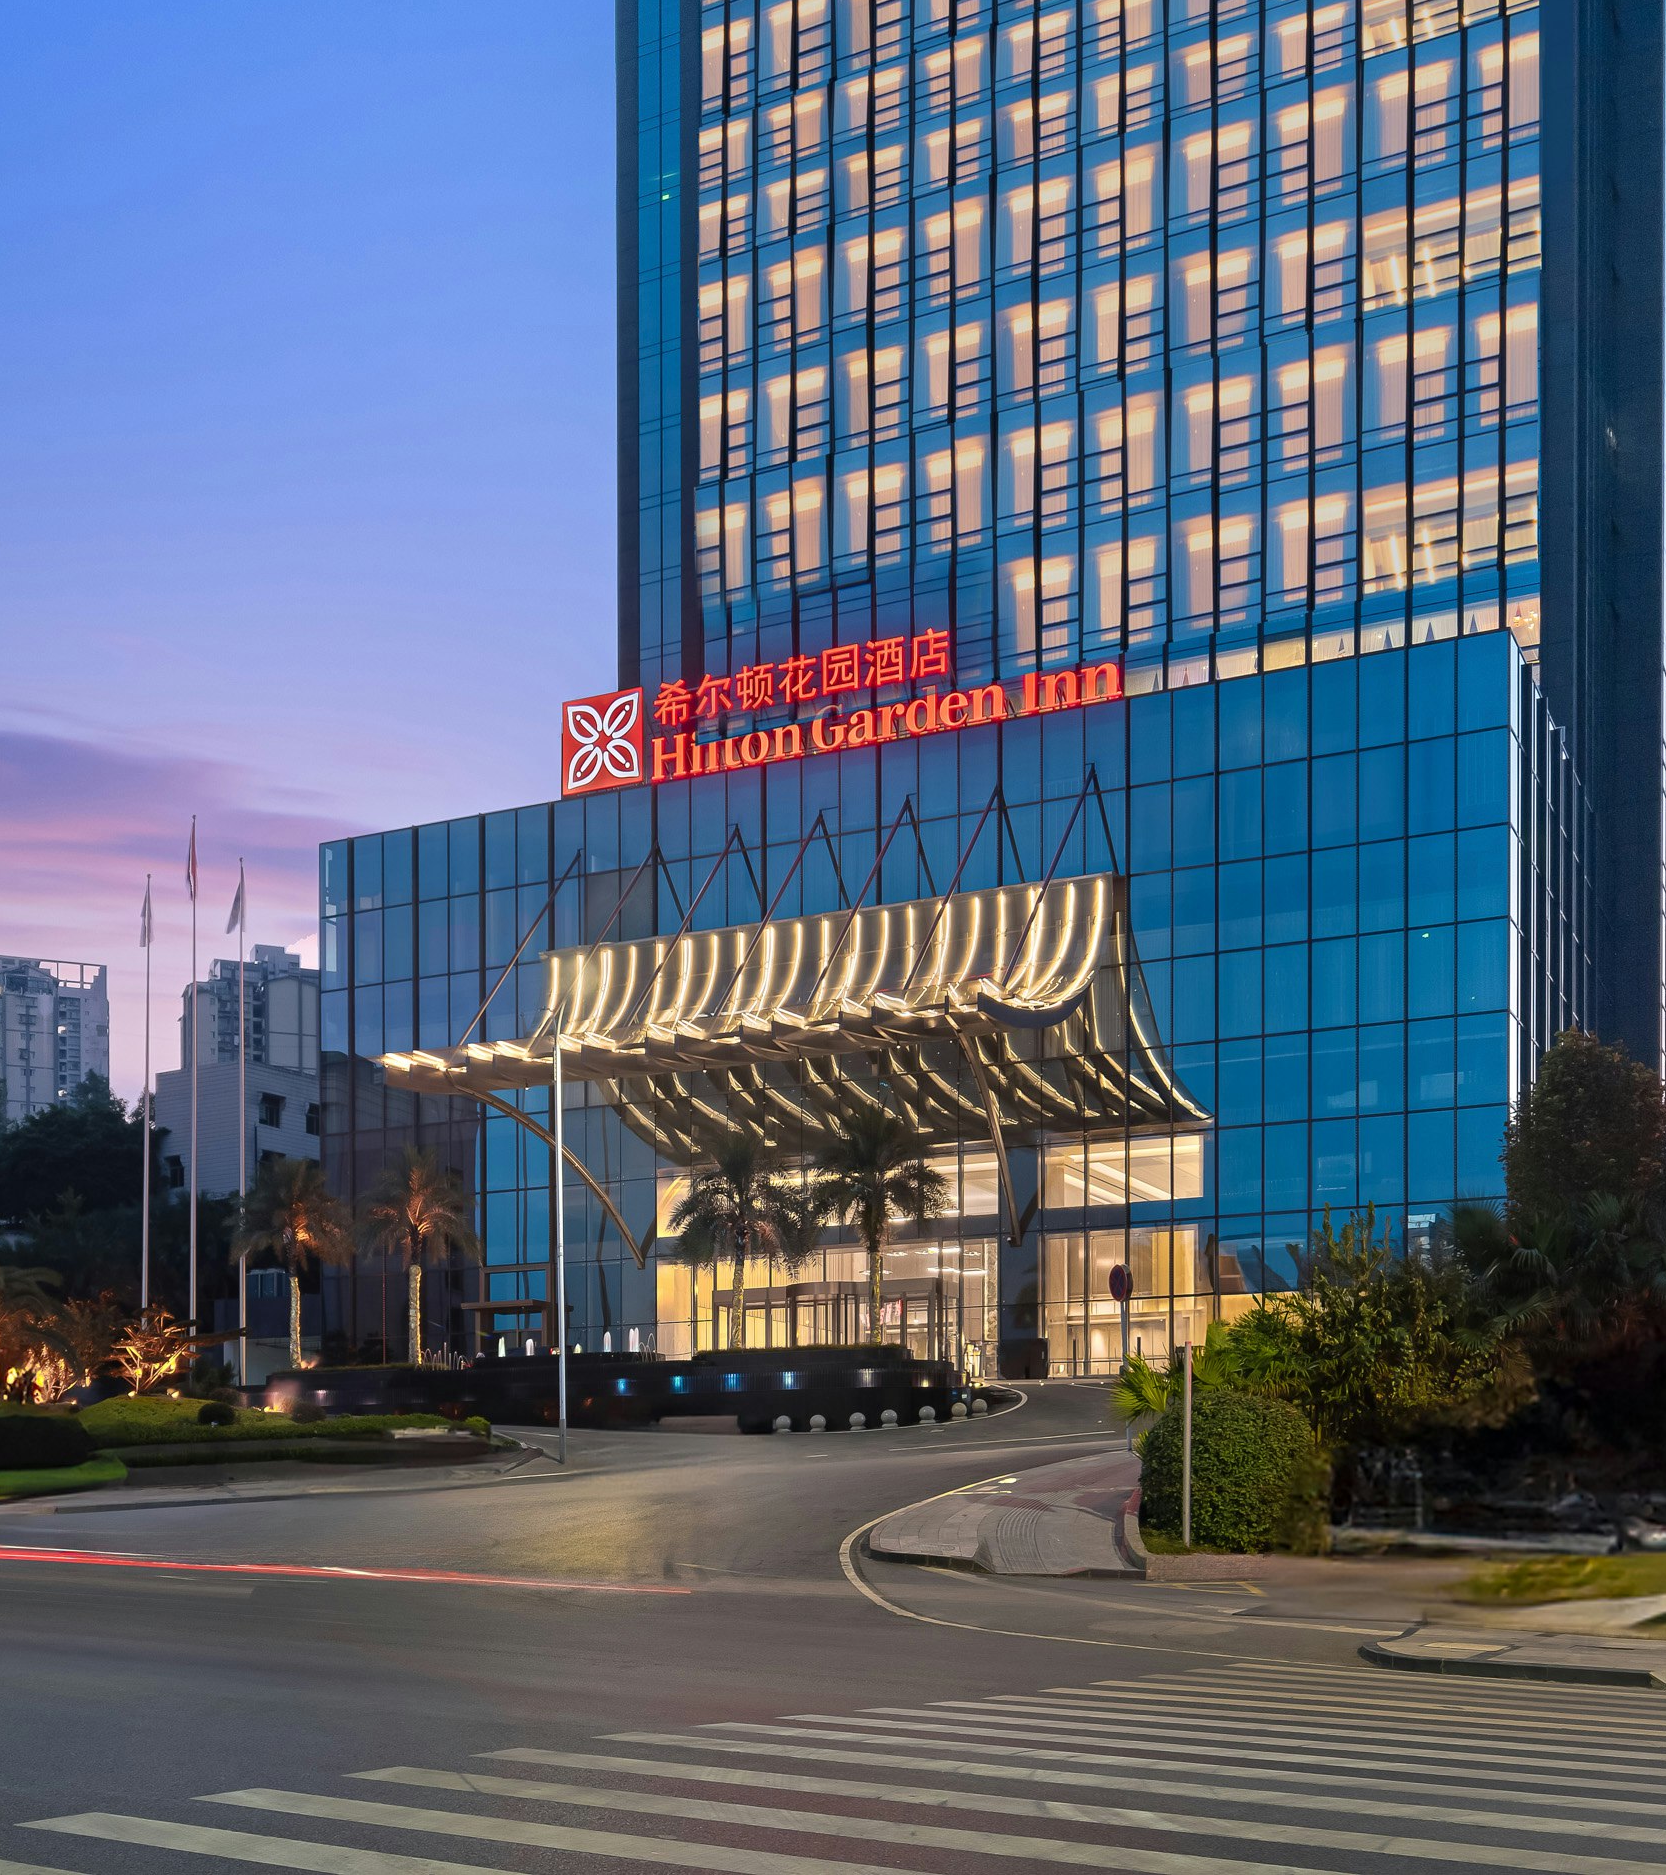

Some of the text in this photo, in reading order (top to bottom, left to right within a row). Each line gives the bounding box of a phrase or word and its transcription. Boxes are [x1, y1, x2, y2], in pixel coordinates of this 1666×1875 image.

[653, 628, 949, 726] 希尔顿花园酒店
[811, 684, 1008, 750] Garden
[1021, 661, 1123, 713] Inn
